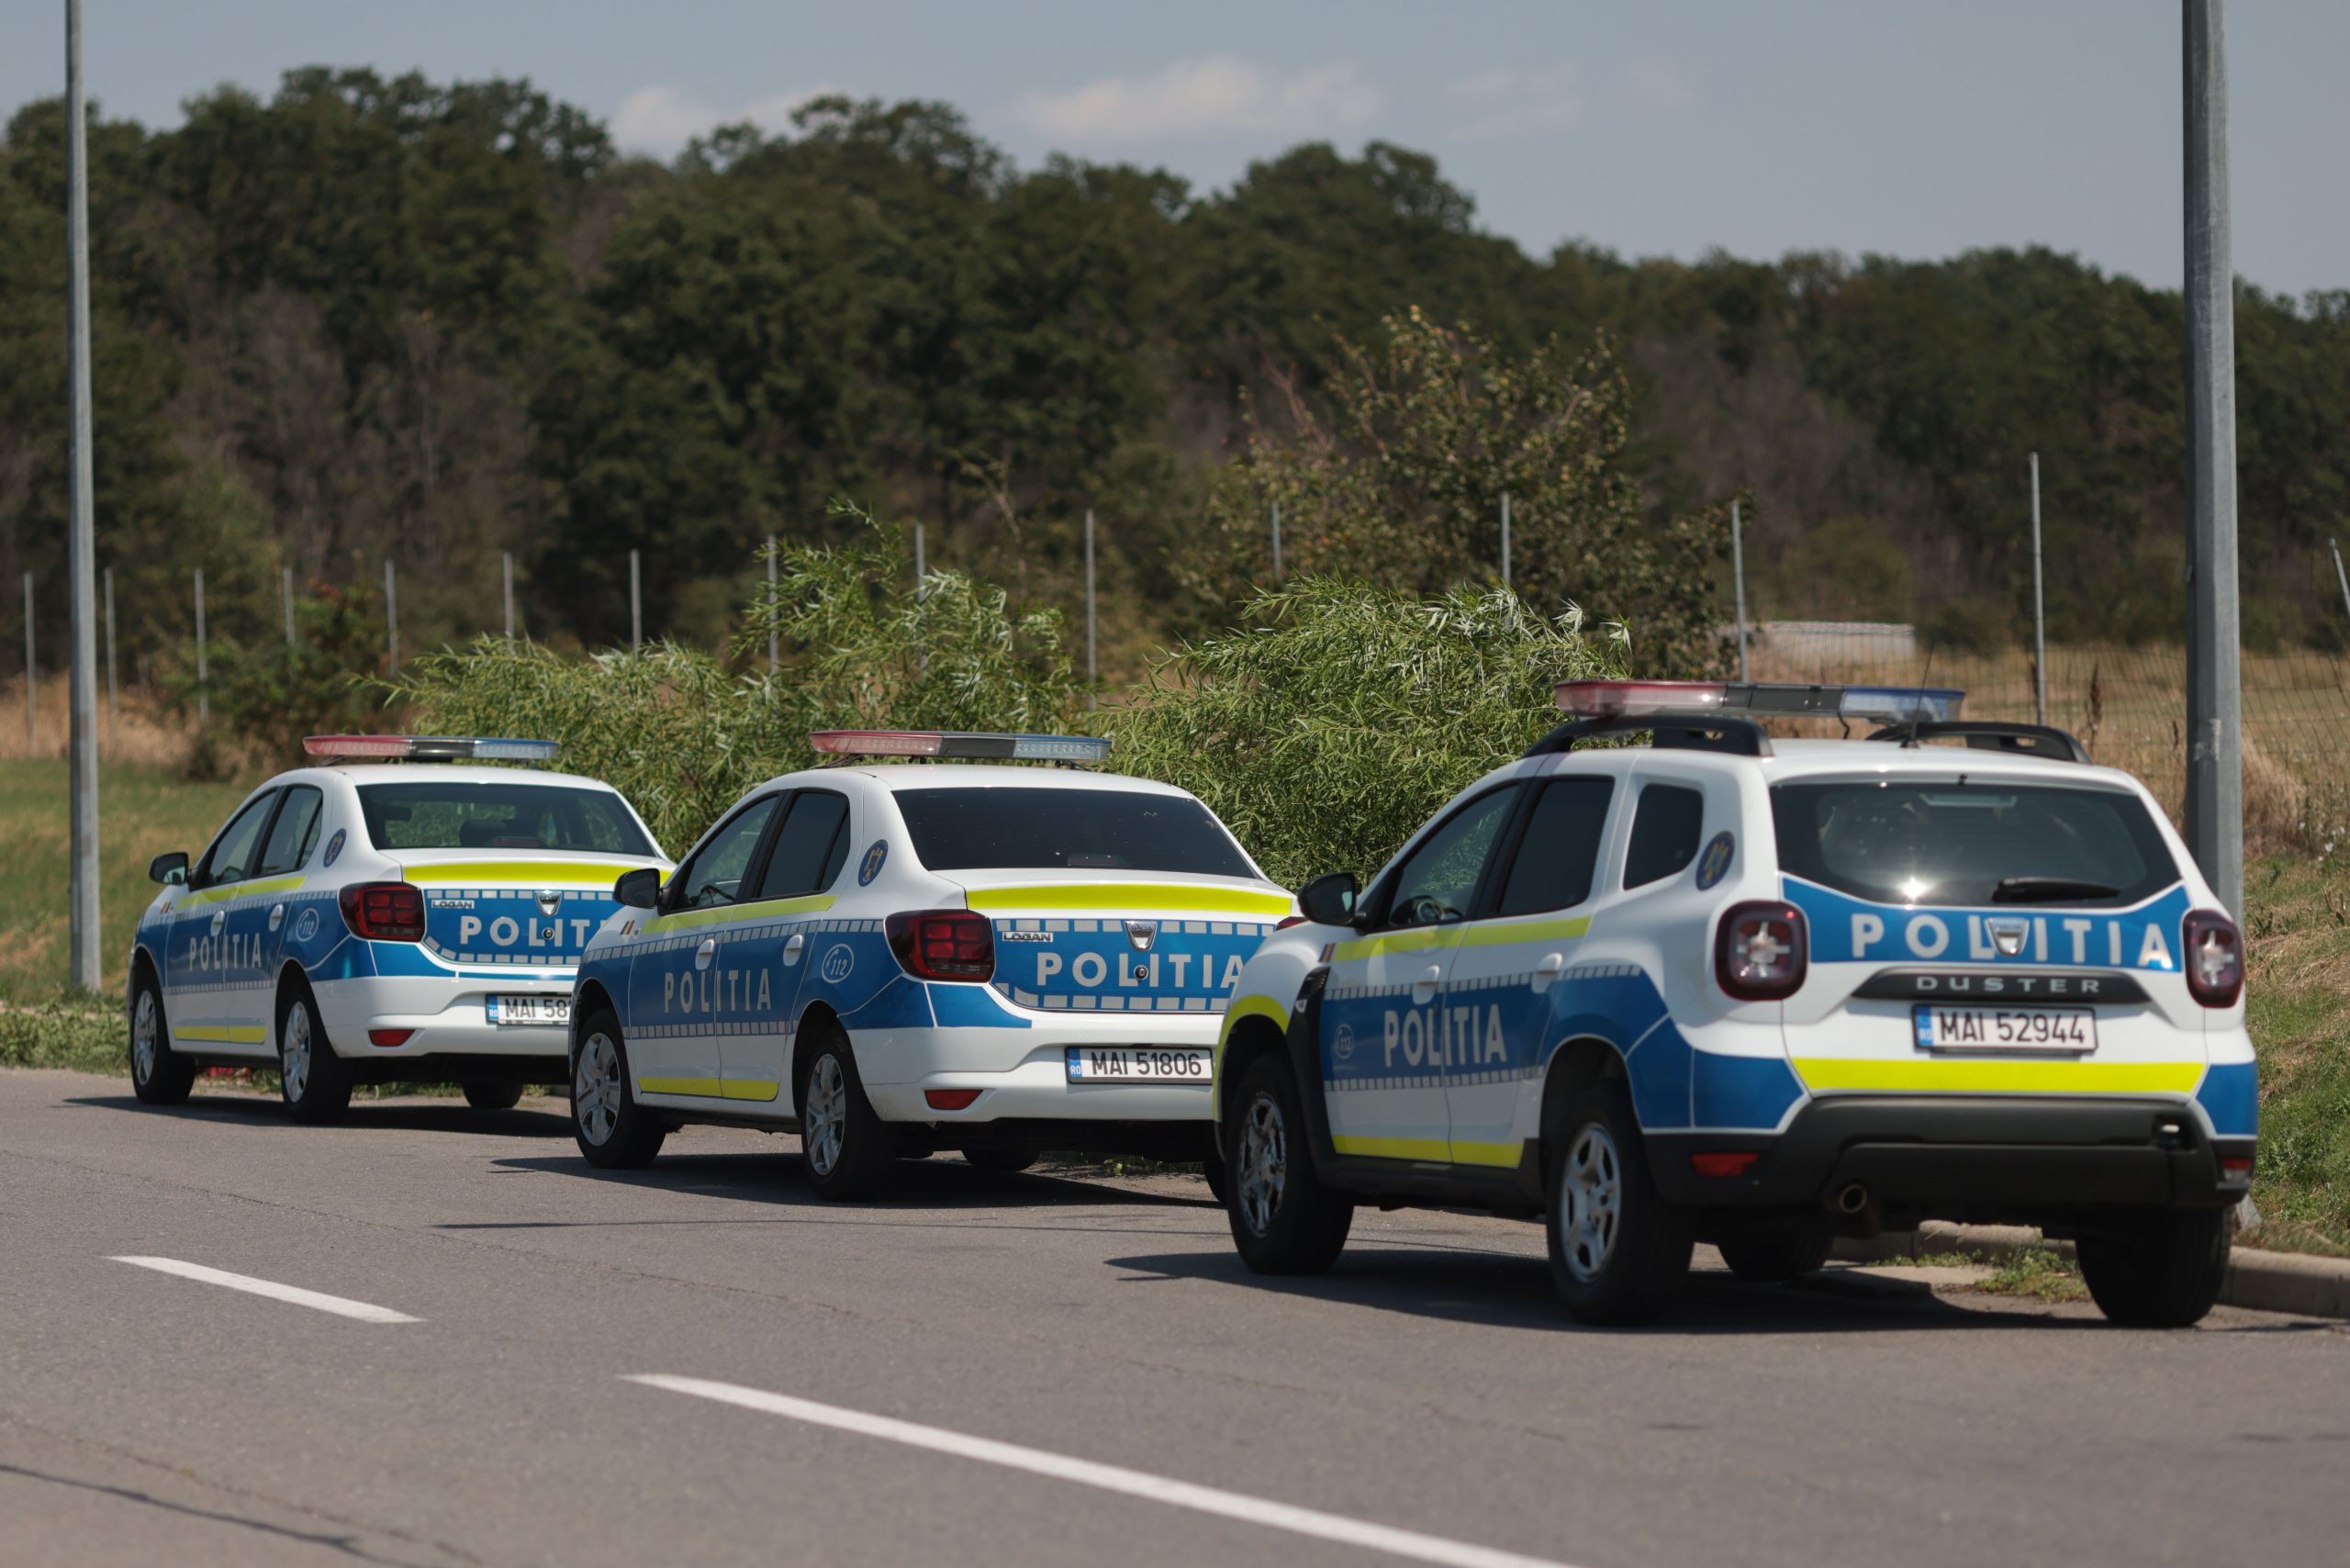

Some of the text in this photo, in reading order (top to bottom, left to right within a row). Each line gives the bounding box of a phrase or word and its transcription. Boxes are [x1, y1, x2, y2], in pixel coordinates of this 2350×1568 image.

[302, 921, 315, 935] 112
[460, 915, 610, 947] POLIT
[1002, 931, 1052, 942] LOGAN
[189, 933, 262, 971] POLITIA
[1852, 913, 2173, 969] POLITIA
[830, 958, 847, 976] 112
[664, 969, 772, 1014] POLITIA
[1916, 976, 2100, 993] DUSTER
[505, 998, 572, 1018] MAI 58
[1383, 1003, 1507, 1068] POLITIA
[1939, 1012, 2085, 1044] MAI 52944
[1070, 1065, 1081, 1075] RO
[1091, 1051, 1203, 1076] MAI 51806
